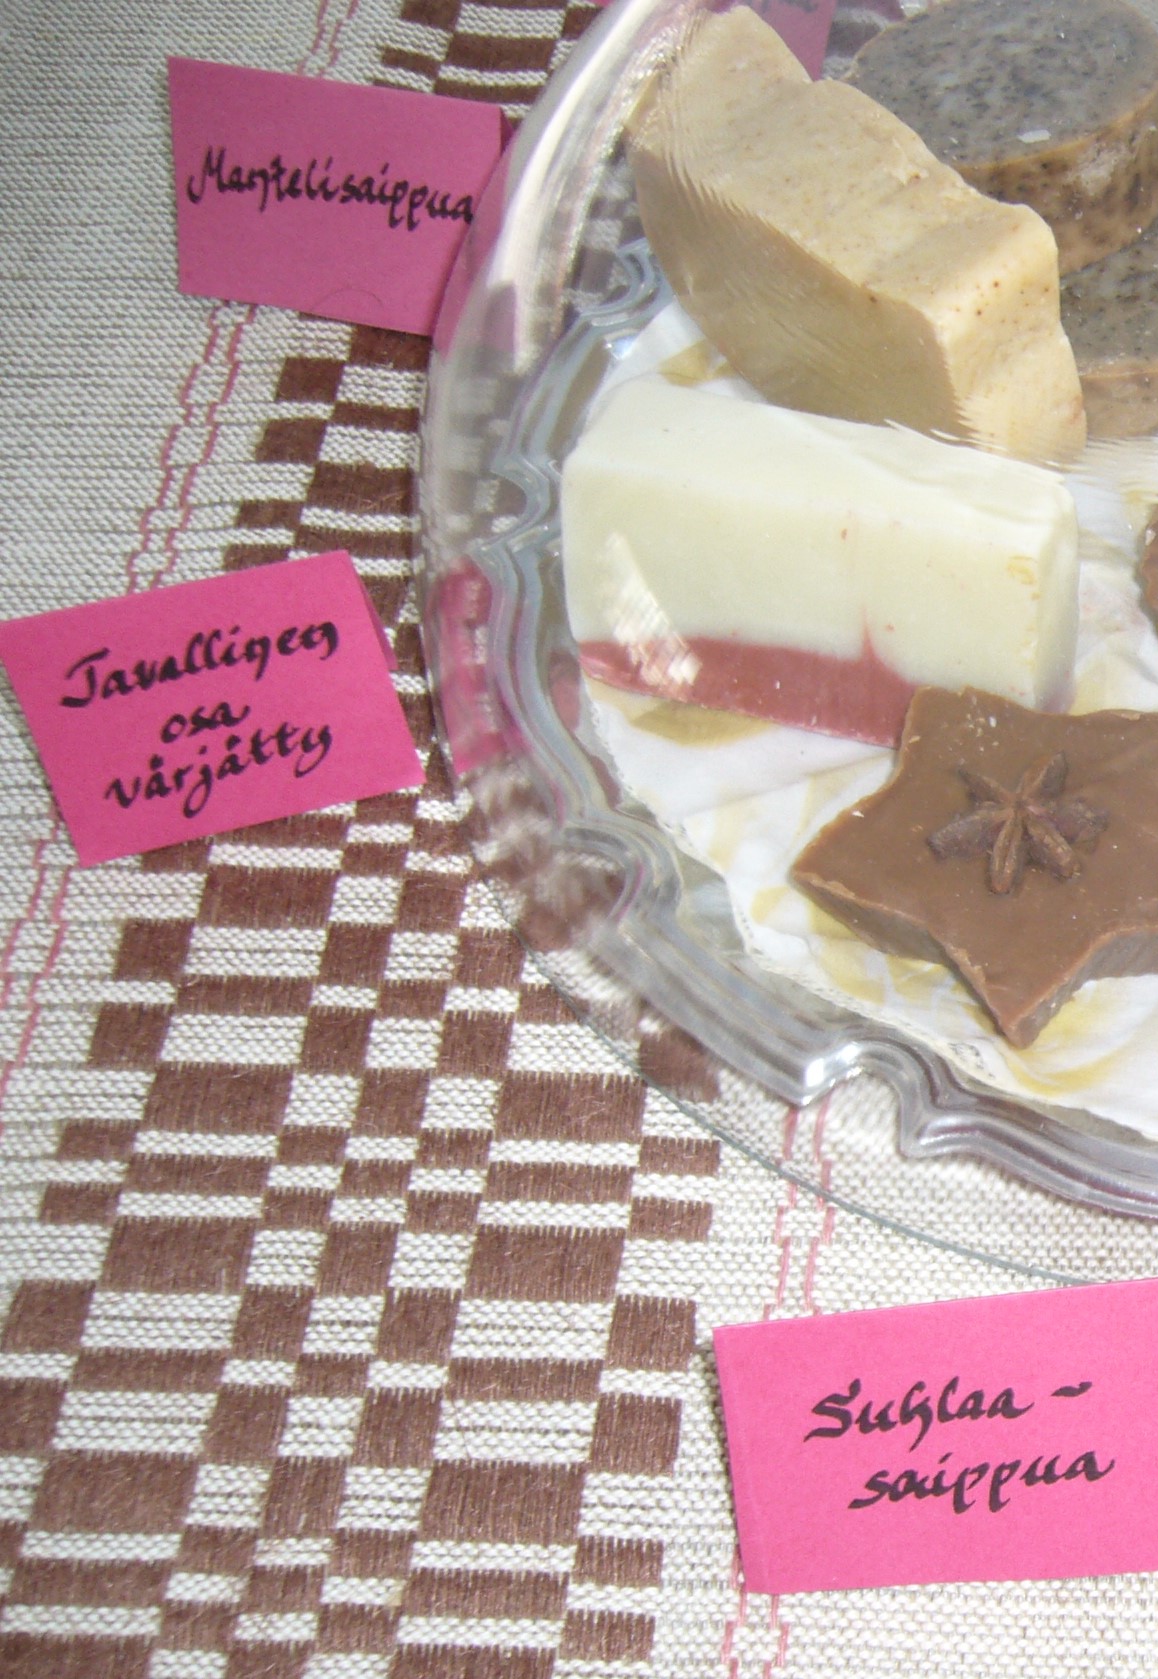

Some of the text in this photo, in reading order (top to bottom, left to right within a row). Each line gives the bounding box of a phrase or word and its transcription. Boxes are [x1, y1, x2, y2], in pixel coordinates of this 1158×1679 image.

[60, 620, 341, 709] Tavallinen
[160, 701, 251, 744] osa
[847, 1449, 1117, 1516] saippua
